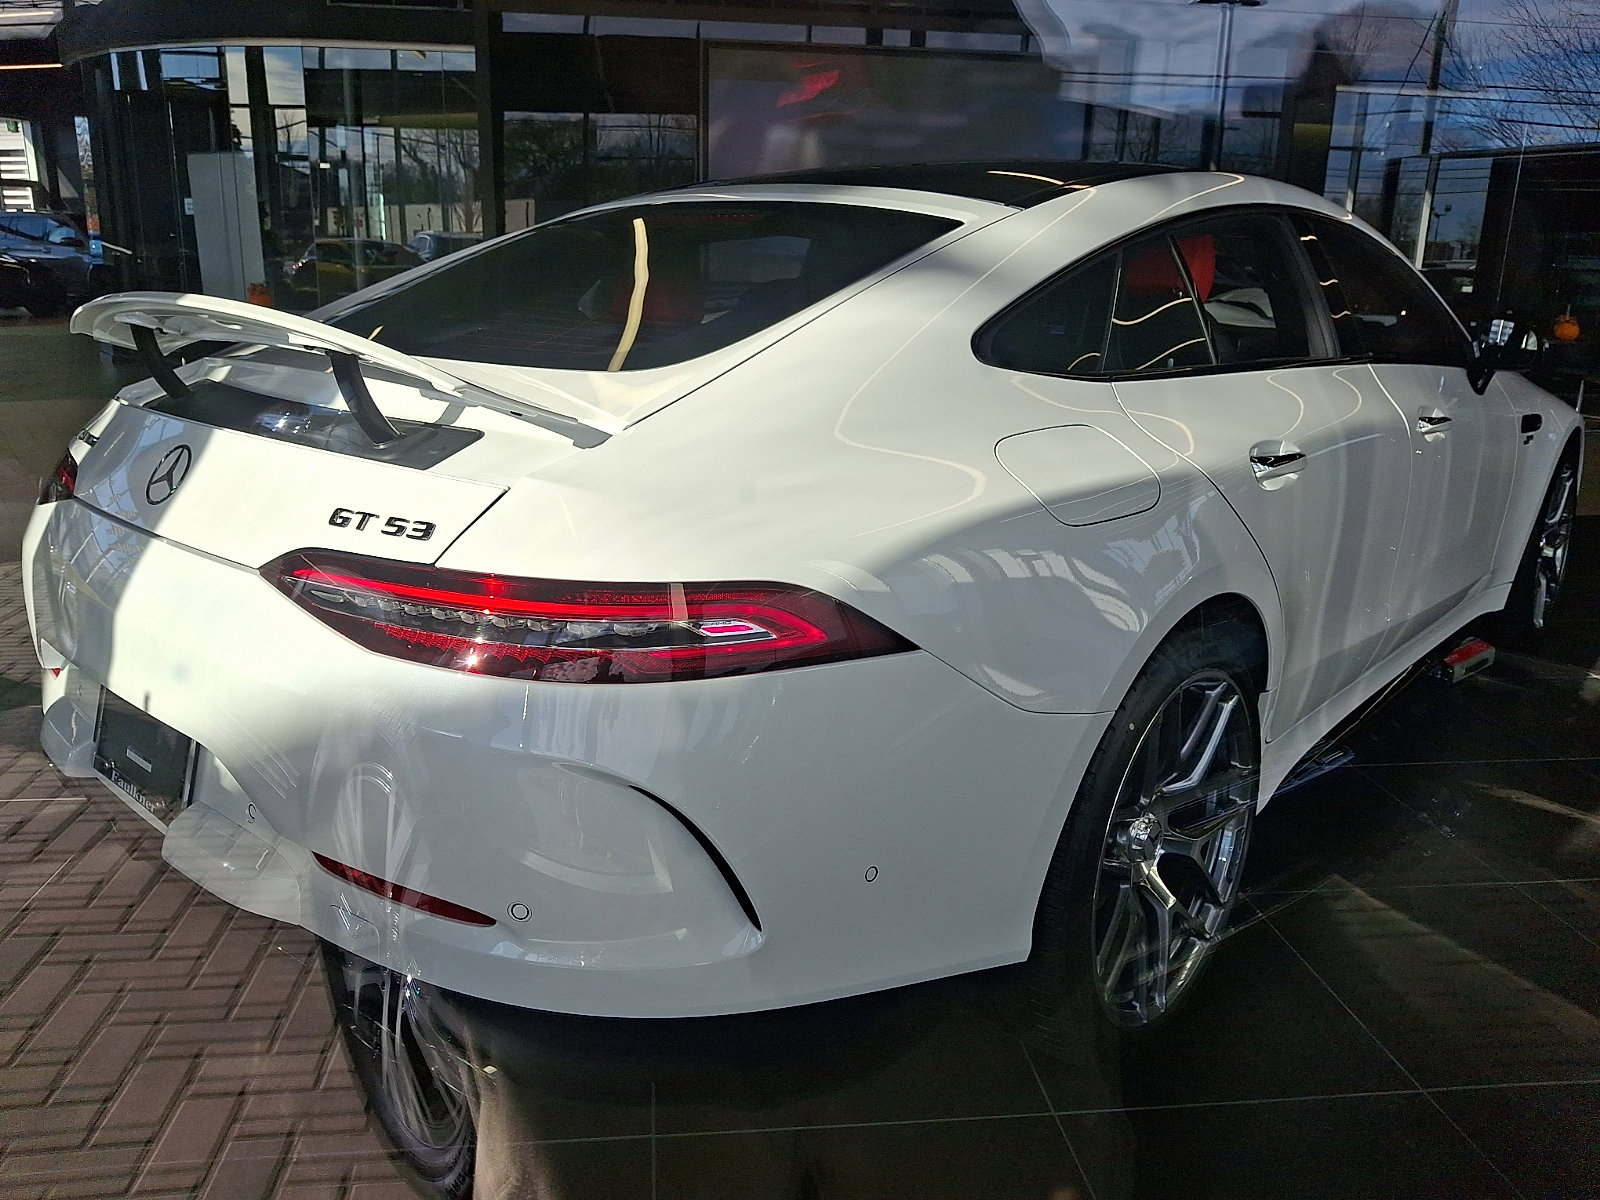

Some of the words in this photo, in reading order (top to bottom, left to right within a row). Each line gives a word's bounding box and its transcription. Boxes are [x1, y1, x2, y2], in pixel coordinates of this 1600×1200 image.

[328, 507, 380, 531] GT
[381, 516, 437, 541] 53
[110, 769, 156, 813] Faulkner
